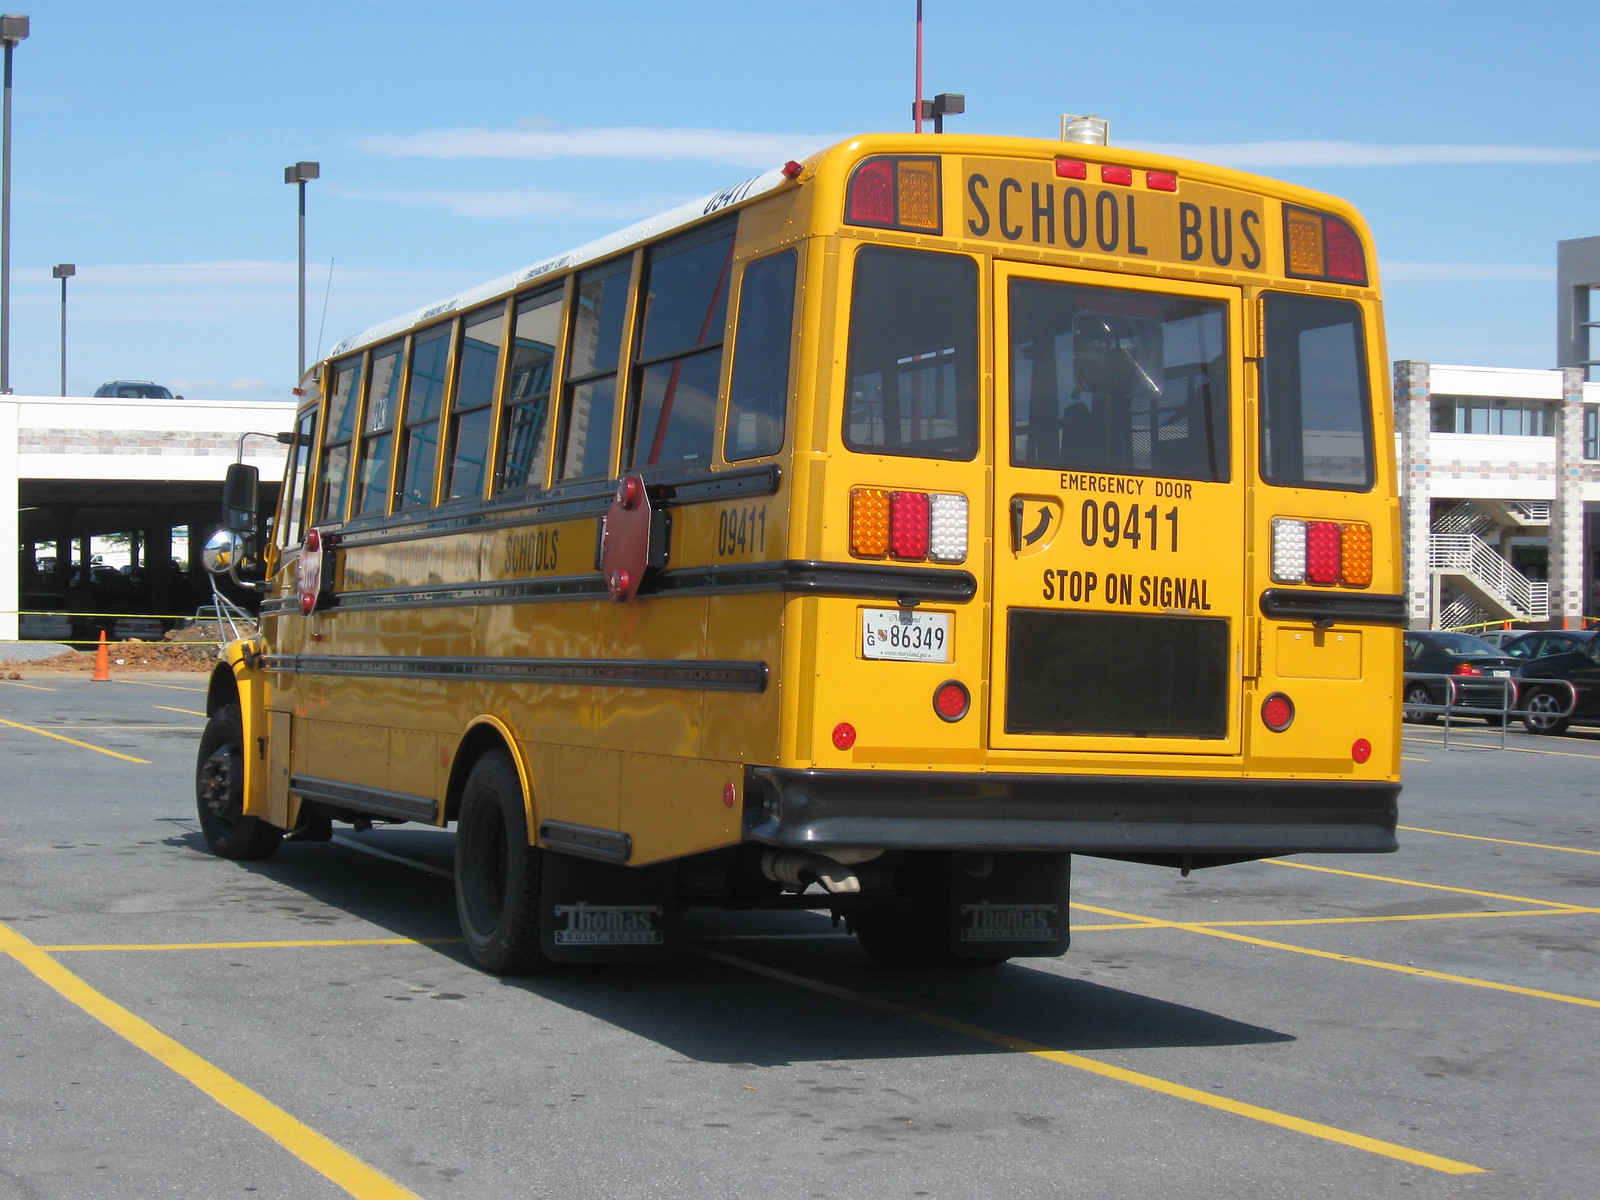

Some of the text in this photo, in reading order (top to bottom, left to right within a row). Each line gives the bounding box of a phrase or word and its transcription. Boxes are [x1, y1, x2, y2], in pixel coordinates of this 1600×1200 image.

[967, 173, 1261, 269] SCHOOL BUS
[1060, 473, 1192, 500] EMERGENCY DOOR
[718, 504, 766, 556] 09411
[1081, 499, 1178, 552] 09411
[504, 529, 559, 573] SCHOOLS
[1043, 569, 1211, 610] STOP ON SIGNAL
[890, 625, 944, 650] 86349
[556, 901, 662, 930] Thomas
[962, 901, 1058, 929] Thomas
[566, 933, 653, 941] BUILT BUSES
